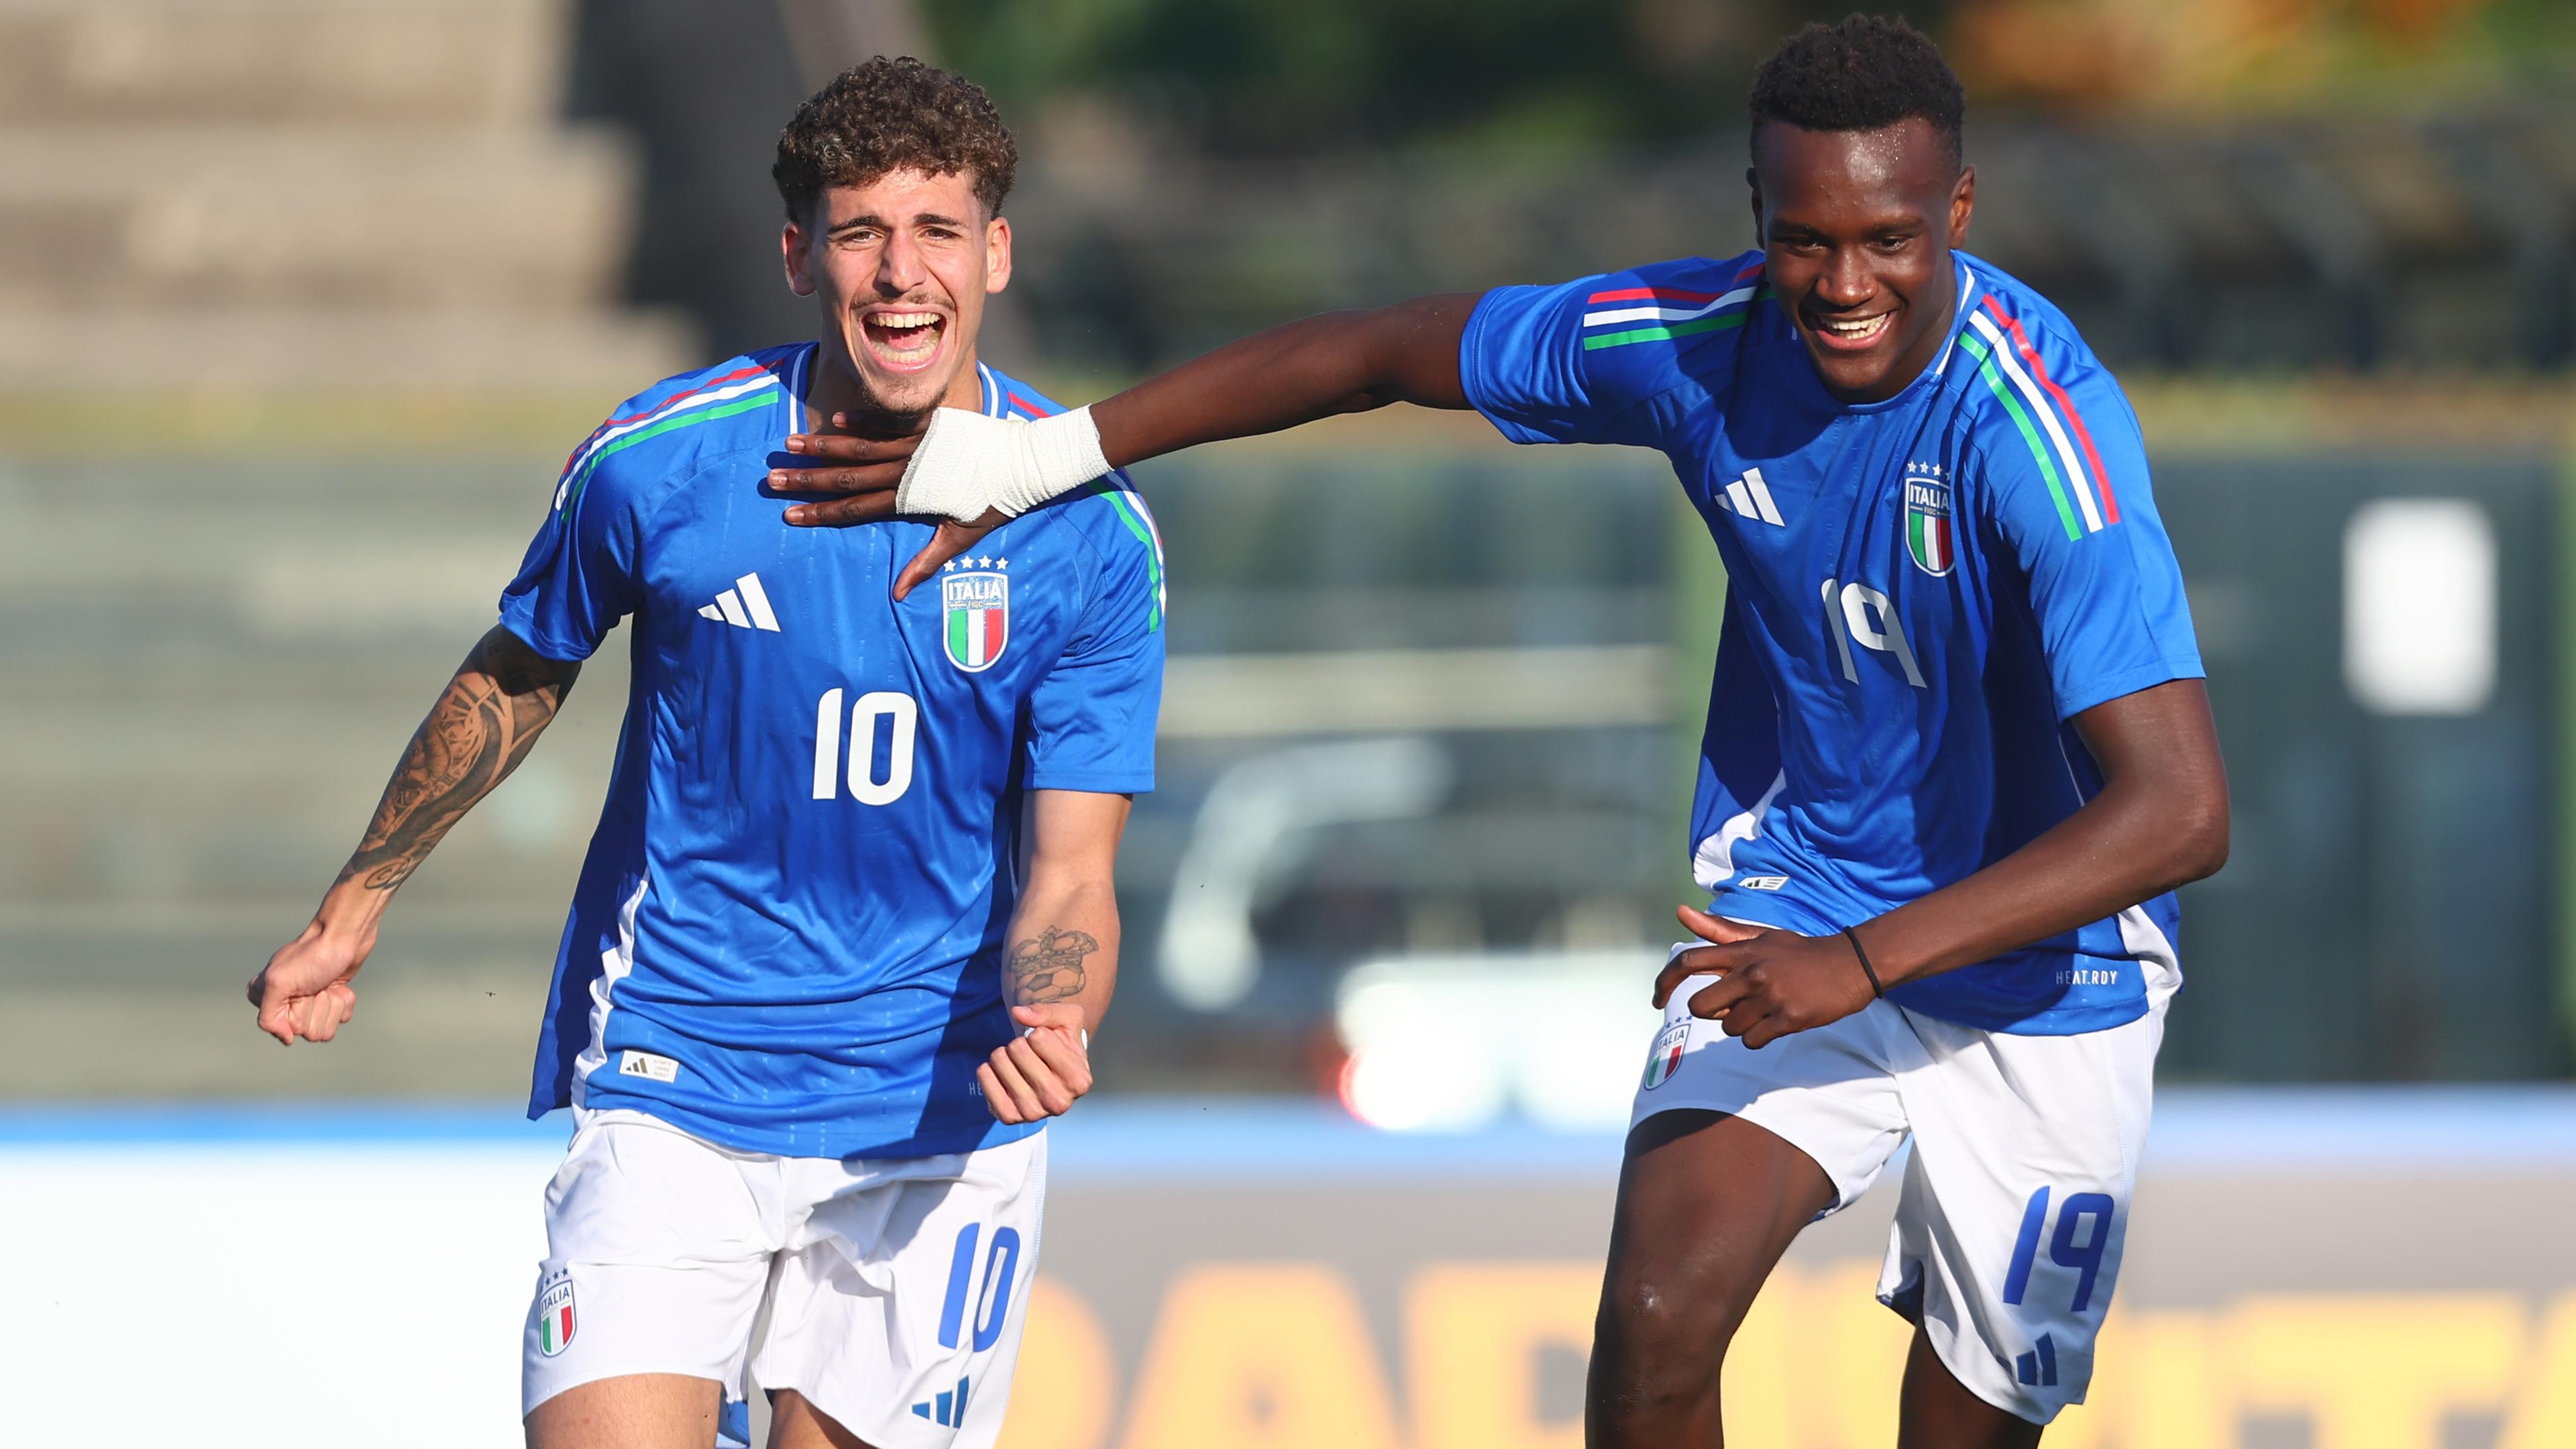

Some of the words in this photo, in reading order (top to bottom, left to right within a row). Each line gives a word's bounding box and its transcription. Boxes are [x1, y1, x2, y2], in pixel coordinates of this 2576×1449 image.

[1910, 484, 1950, 511] ITALIA
[948, 581, 1003, 601] ITALIA
[1821, 578, 1928, 689] 19
[812, 688, 918, 806] 10
[2055, 970, 2118, 985] HEAT.RDY
[2002, 1185, 2115, 1312] 19
[541, 1286, 570, 1314] ITALIA
[937, 1222, 1020, 1353] 10
